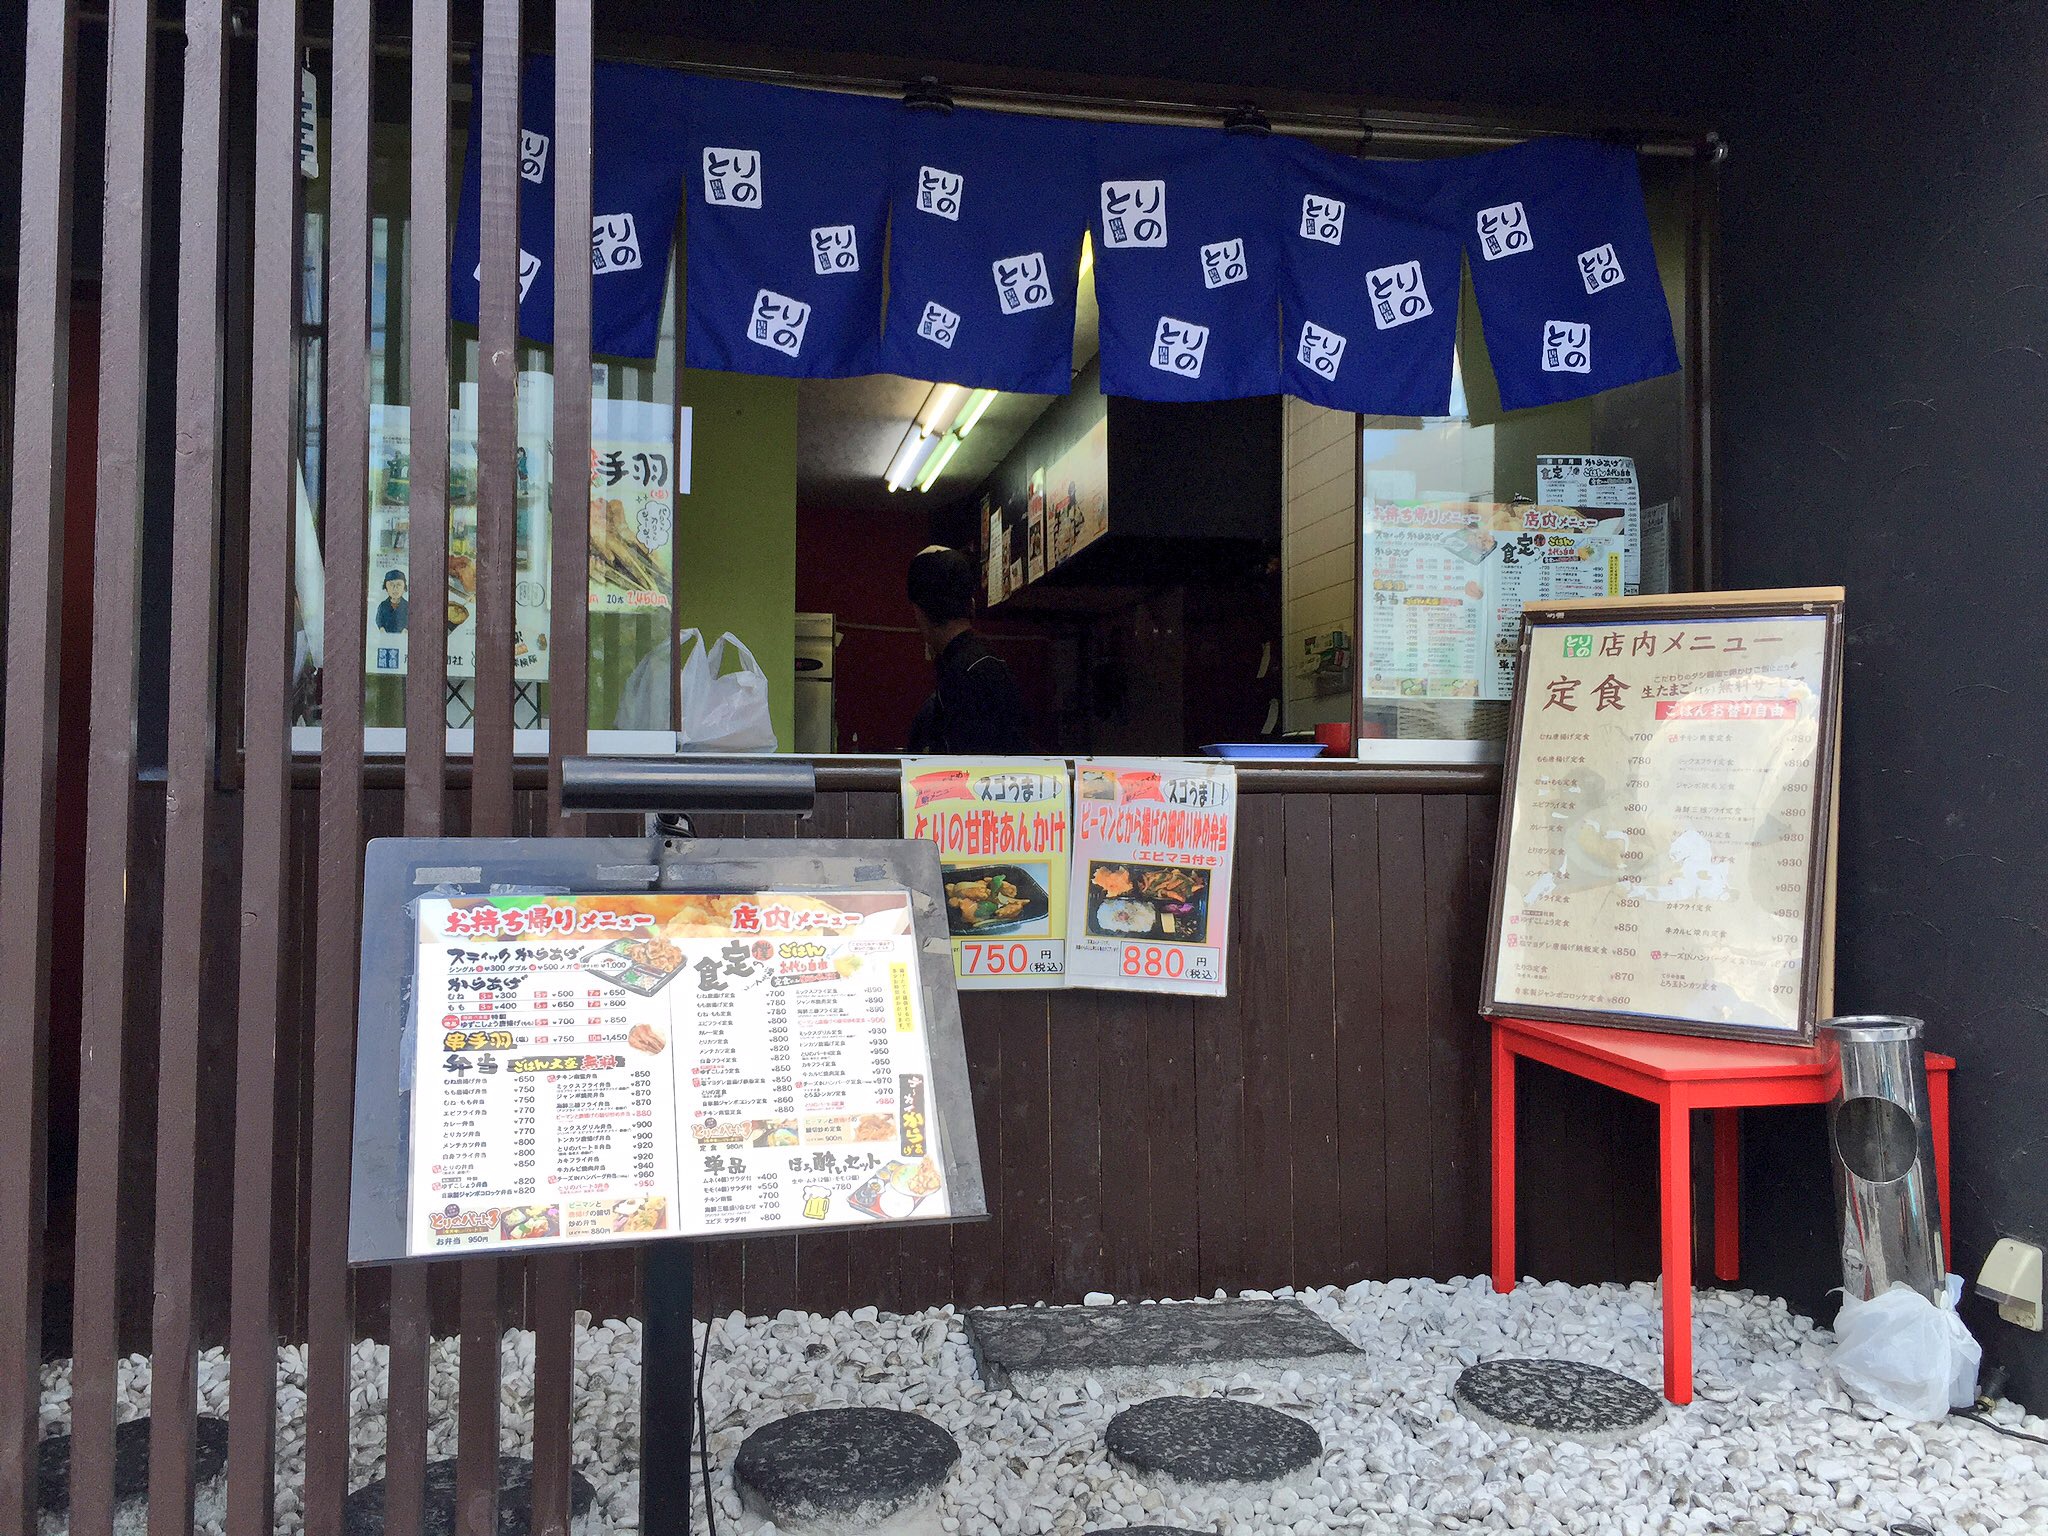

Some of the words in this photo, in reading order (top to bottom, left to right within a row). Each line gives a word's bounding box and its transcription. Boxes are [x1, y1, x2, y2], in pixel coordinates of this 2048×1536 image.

[707, 151, 757, 178] とり
[731, 182, 758, 202] の
[921, 170, 960, 197] とり
[936, 197, 958, 215] の
[1106, 185, 1161, 217] とり
[1306, 198, 1343, 223] とり
[1480, 206, 1523, 235] とり
[593, 217, 631, 243] とり
[1133, 218, 1163, 242] の
[1320, 223, 1340, 240] の
[814, 229, 852, 251] とり
[1505, 230, 1529, 249] の
[611, 248, 637, 266] の
[835, 251, 855, 268] の
[1204, 242, 1241, 268] とり
[1581, 247, 1612, 274] とり
[998, 257, 1042, 286] とり
[1224, 262, 1244, 279] の
[1601, 267, 1621, 286] の
[1371, 265, 1420, 297] とり
[1024, 285, 1048, 304] の
[758, 295, 805, 327] とり
[1399, 295, 1427, 317] の
[926, 305, 956, 330] とり
[772, 328, 798, 349] の
[934, 329, 952, 344] の
[1159, 321, 1205, 350] とり
[1304, 325, 1343, 358] とり
[1547, 324, 1587, 349] とり
[1174, 352, 1198, 372] の
[1315, 356, 1336, 375] の
[1564, 350, 1587, 369] の
[597, 450, 668, 487] 手羽
[1525, 511, 1598, 528] 店内メニュー
[1567, 635, 1591, 646] とり
[1598, 630, 1783, 658] 店内メニュー
[1577, 646, 1590, 657] の
[1541, 674, 1631, 712] 定食
[1641, 680, 1693, 699] 生たまご
[1665, 702, 1785, 719] ごはんお替り自由
[1630, 734, 1653, 742] ¥700
[1628, 757, 1651, 765] ¥780
[1626, 780, 1649, 788] ¥780
[1783, 784, 1808, 793] ¥890
[1624, 804, 1647, 812] ¥800
[1781, 809, 1806, 817] ¥890
[914, 809, 1066, 855] とりの甘酢あんかけ
[1779, 833, 1804, 842] ¥930
[1777, 859, 1802, 867] ¥930
[1776, 884, 1800, 892] ¥950
[1616, 900, 1640, 908] ¥820
[444, 906, 653, 934] お持ち帰りメニュー
[733, 904, 862, 930] 店内メニュー
[1774, 909, 1799, 918] ¥950
[1614, 924, 1638, 932] ¥850
[1772, 934, 1798, 943] ¥970
[779, 942, 826, 958] ごはん
[963, 944, 1029, 974] 750
[1040, 949, 1052, 961] 円
[1612, 949, 1636, 957] ¥850
[1029, 961, 1064, 974] (税込)
[1123, 946, 1185, 978] 880
[1196, 956, 1207, 967] 円
[1184, 967, 1219, 981] (税込)
[1610, 973, 1634, 982] ¥870
[447, 975, 528, 992] からあげ
[495, 1002, 517, 1010] ¥400
[605, 1016, 627, 1024] ¥850
[444, 1031, 514, 1051] 串手羽
[553, 1035, 575, 1043] ¥750
[442, 1053, 498, 1077] 弁当
[514, 1075, 535, 1083] ¥650
[630, 1070, 651, 1078] ¥850
[631, 1079, 651, 1087] ¥870
[514, 1106, 535, 1114] ¥770
[514, 1117, 535, 1125] ¥770
[514, 1127, 536, 1135] ¥770
[514, 1138, 536, 1146] ¥800
[703, 1154, 747, 1176] 単品
[788, 1150, 881, 1175] ほろ酔いセット
[757, 1182, 779, 1190] ¥550
[759, 1201, 780, 1209] ¥700
[760, 1213, 781, 1221] ¥800
